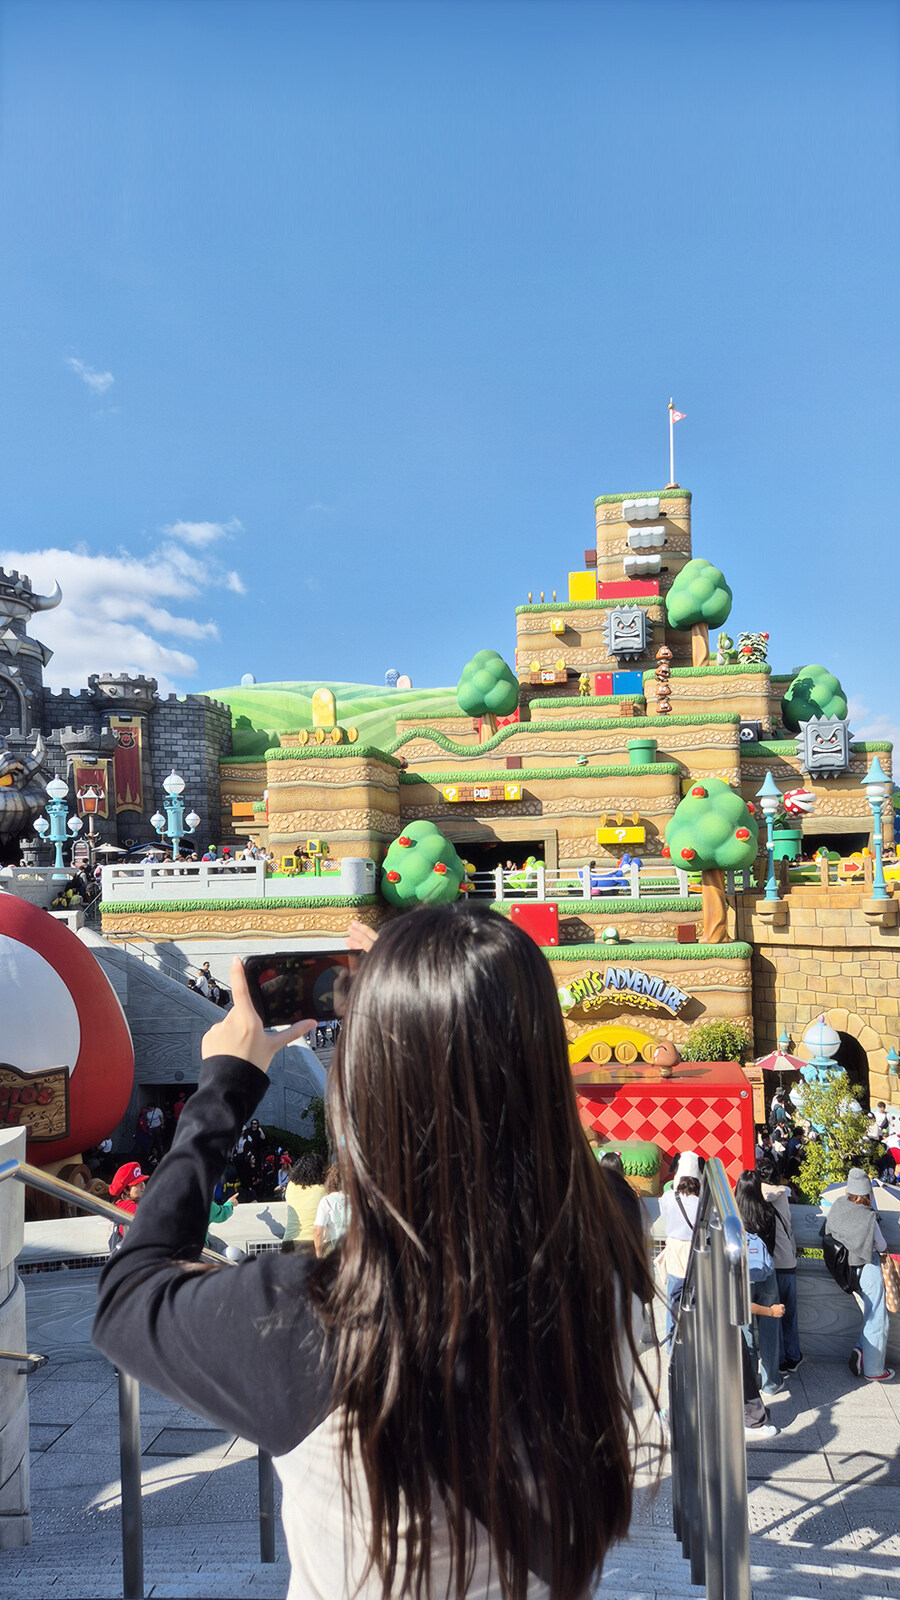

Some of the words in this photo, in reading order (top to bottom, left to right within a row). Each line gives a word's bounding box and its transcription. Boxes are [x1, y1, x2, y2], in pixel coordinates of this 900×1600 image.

[445, 788, 457, 800] ?
[507, 786, 518, 799] ?
[614, 829, 627, 842] ?
[604, 966, 688, 1012] ADVENTURE
